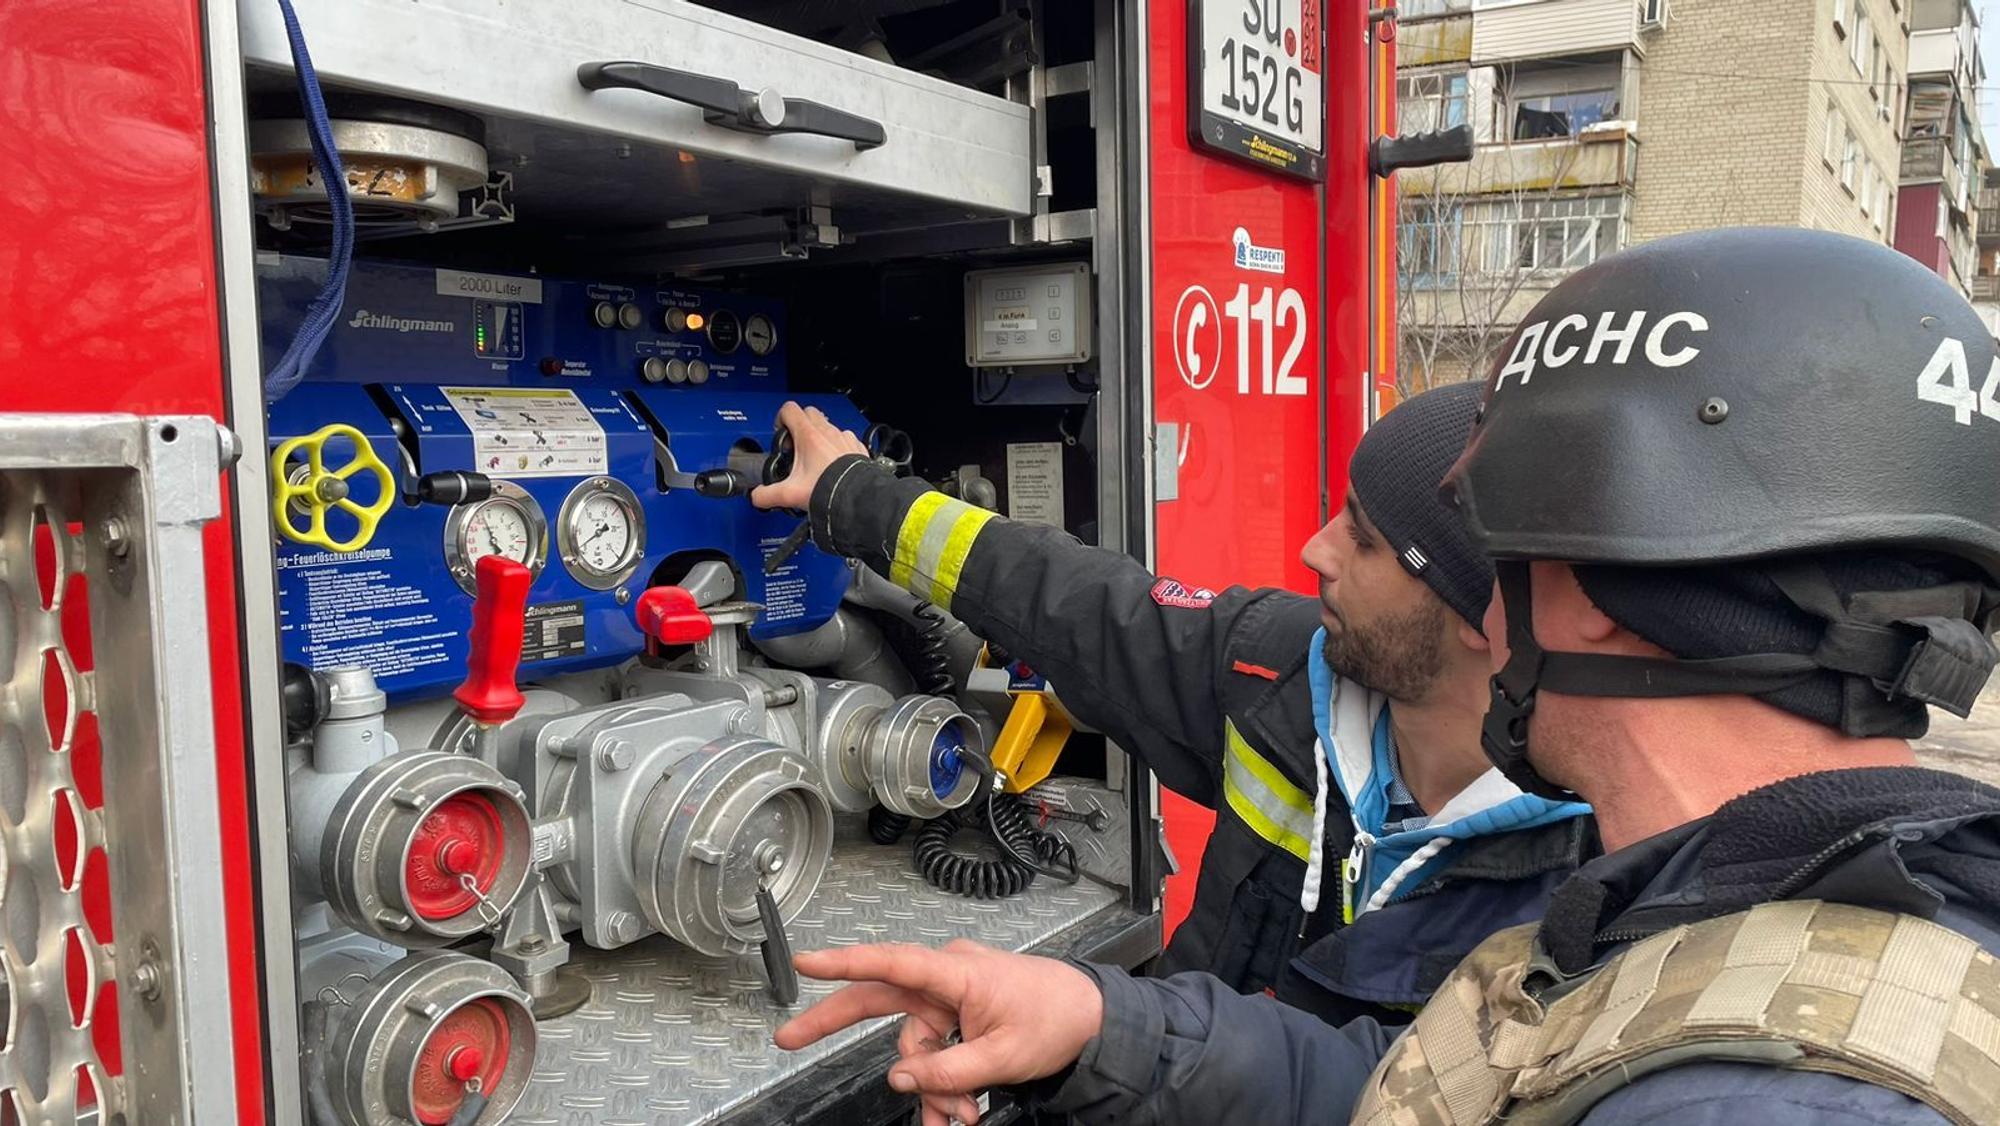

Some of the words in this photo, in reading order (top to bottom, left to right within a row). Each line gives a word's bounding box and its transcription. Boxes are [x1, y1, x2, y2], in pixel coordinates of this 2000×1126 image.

[1221, 37, 1303, 134] 152G
[348, 309, 454, 333] Schlingmann
[460, 276, 492, 293] 2000
[495, 280, 522, 296] Liter
[1225, 283, 1308, 395] 112
[1495, 311, 1709, 392] ДСНС
